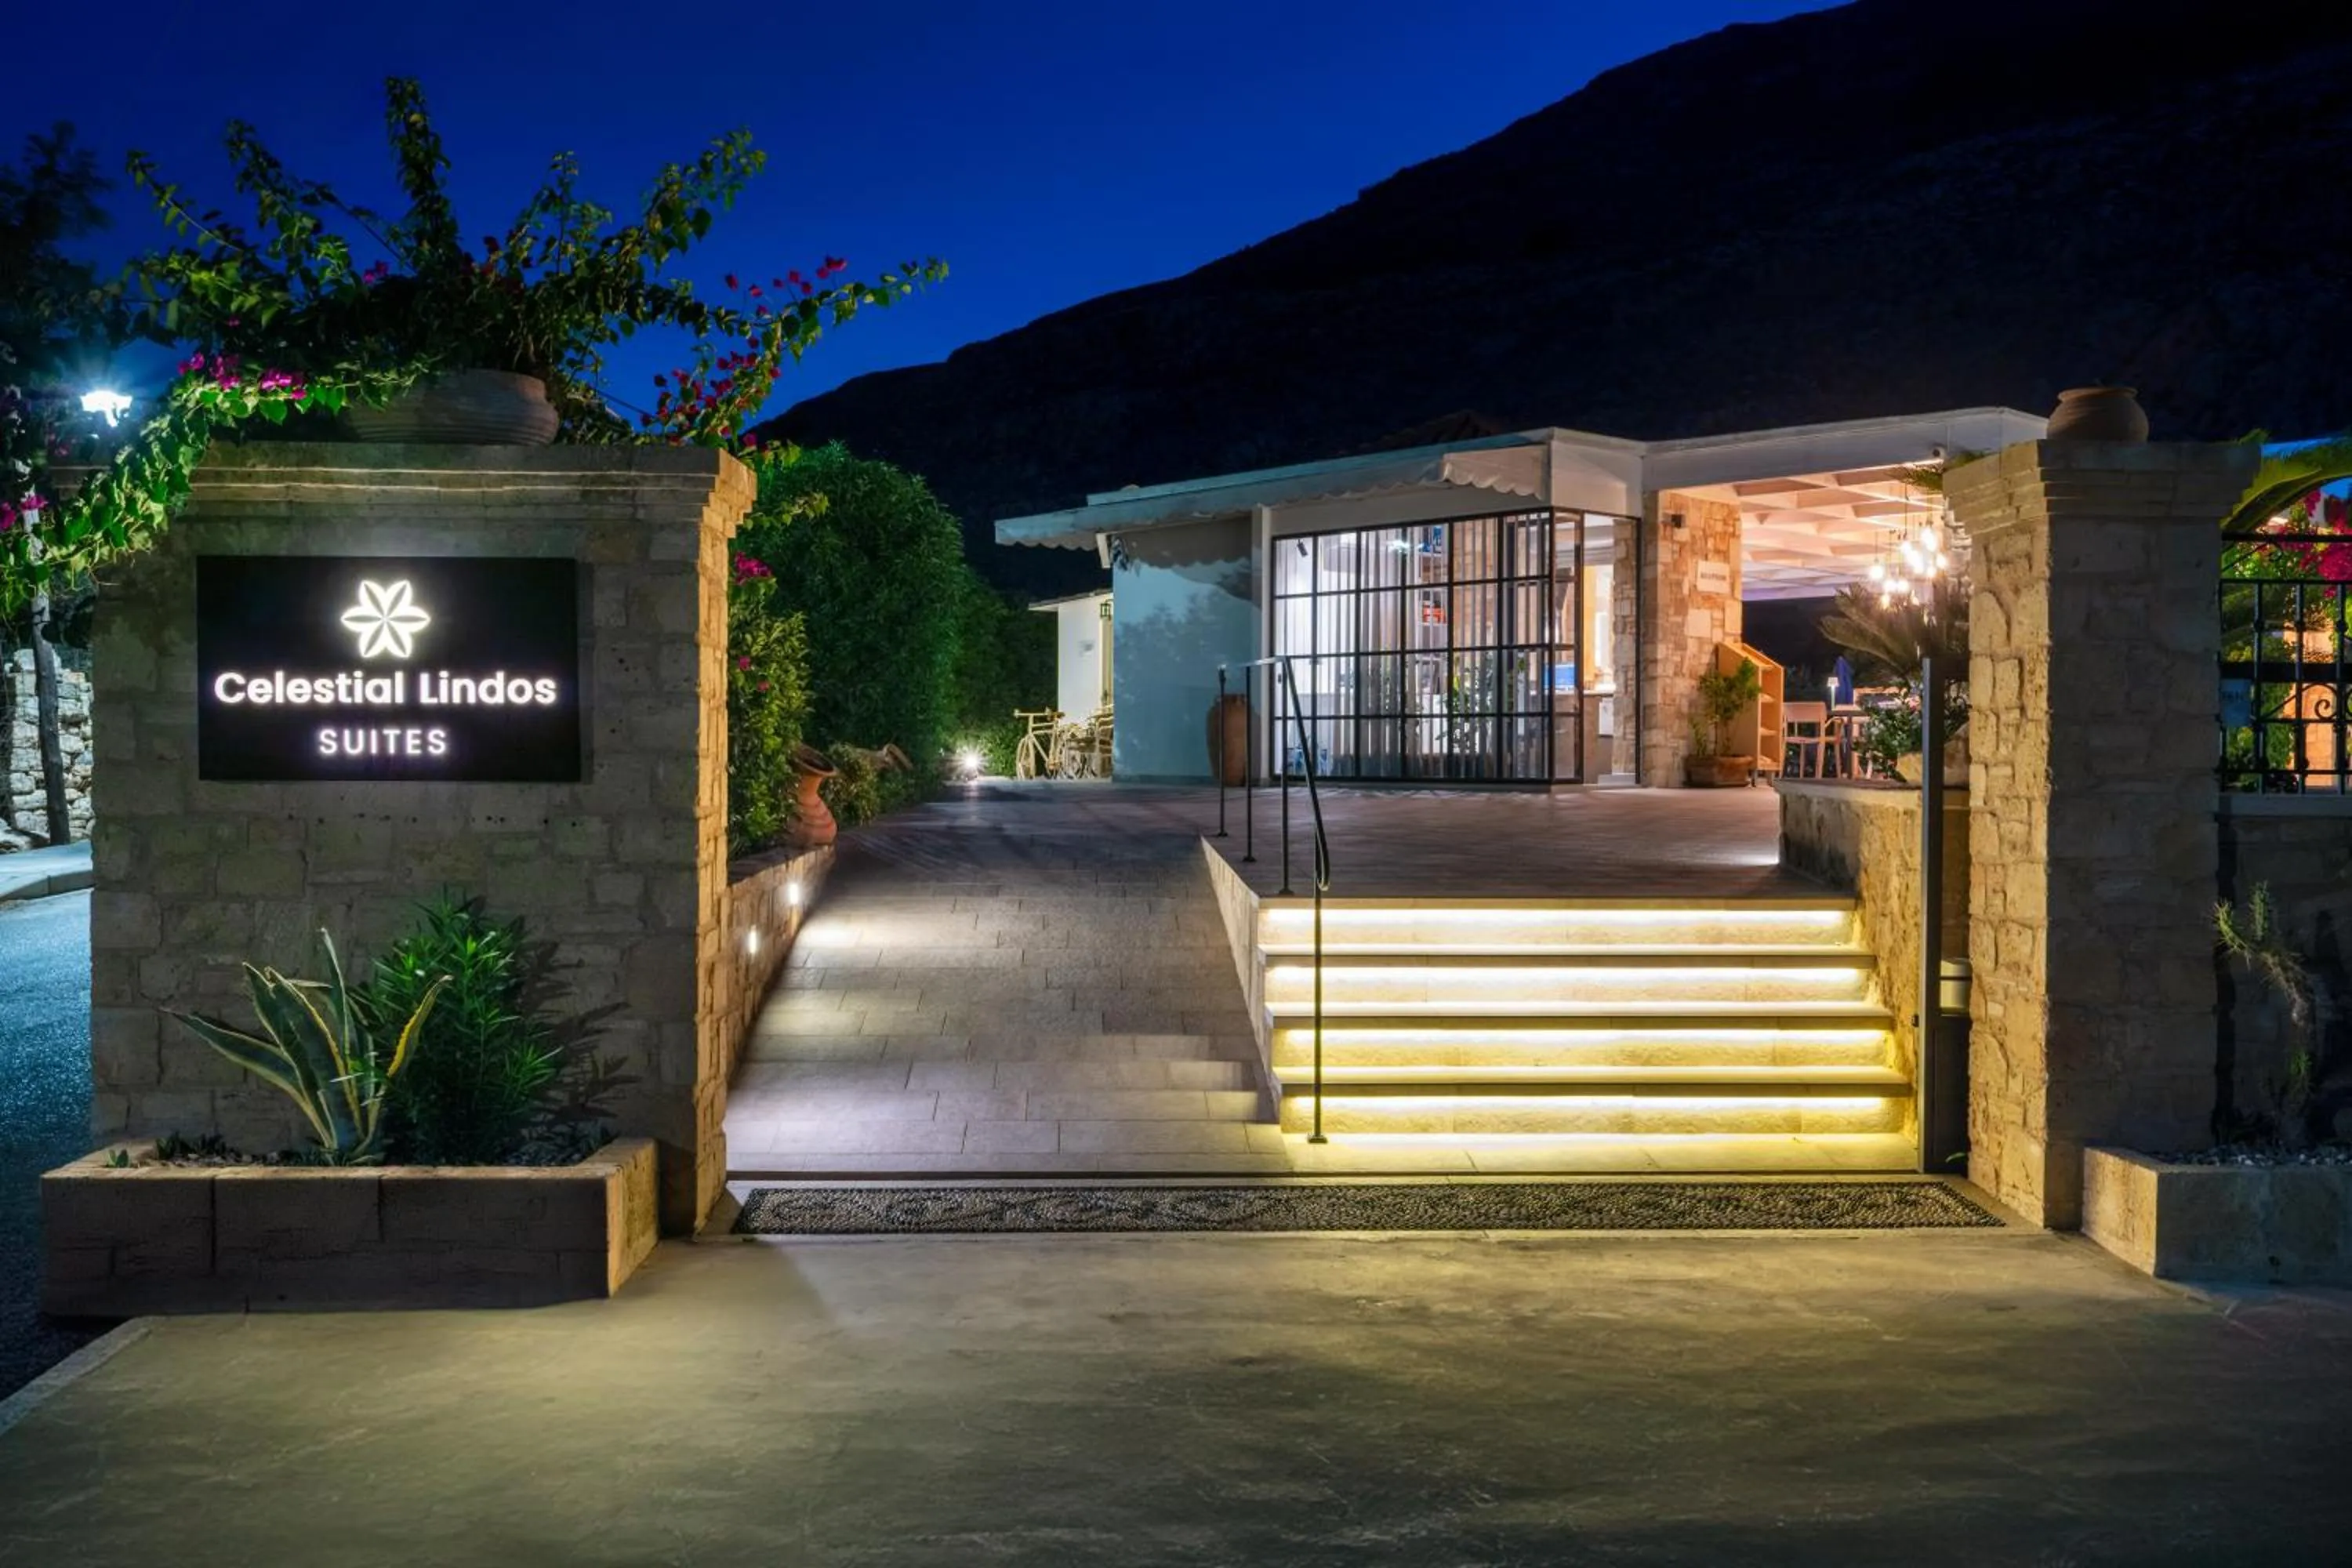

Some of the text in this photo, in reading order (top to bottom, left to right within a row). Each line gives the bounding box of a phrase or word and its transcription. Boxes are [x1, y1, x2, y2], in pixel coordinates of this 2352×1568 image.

[214, 670, 557, 706] Celestial Lindos
[318, 728, 448, 757] SUITES
